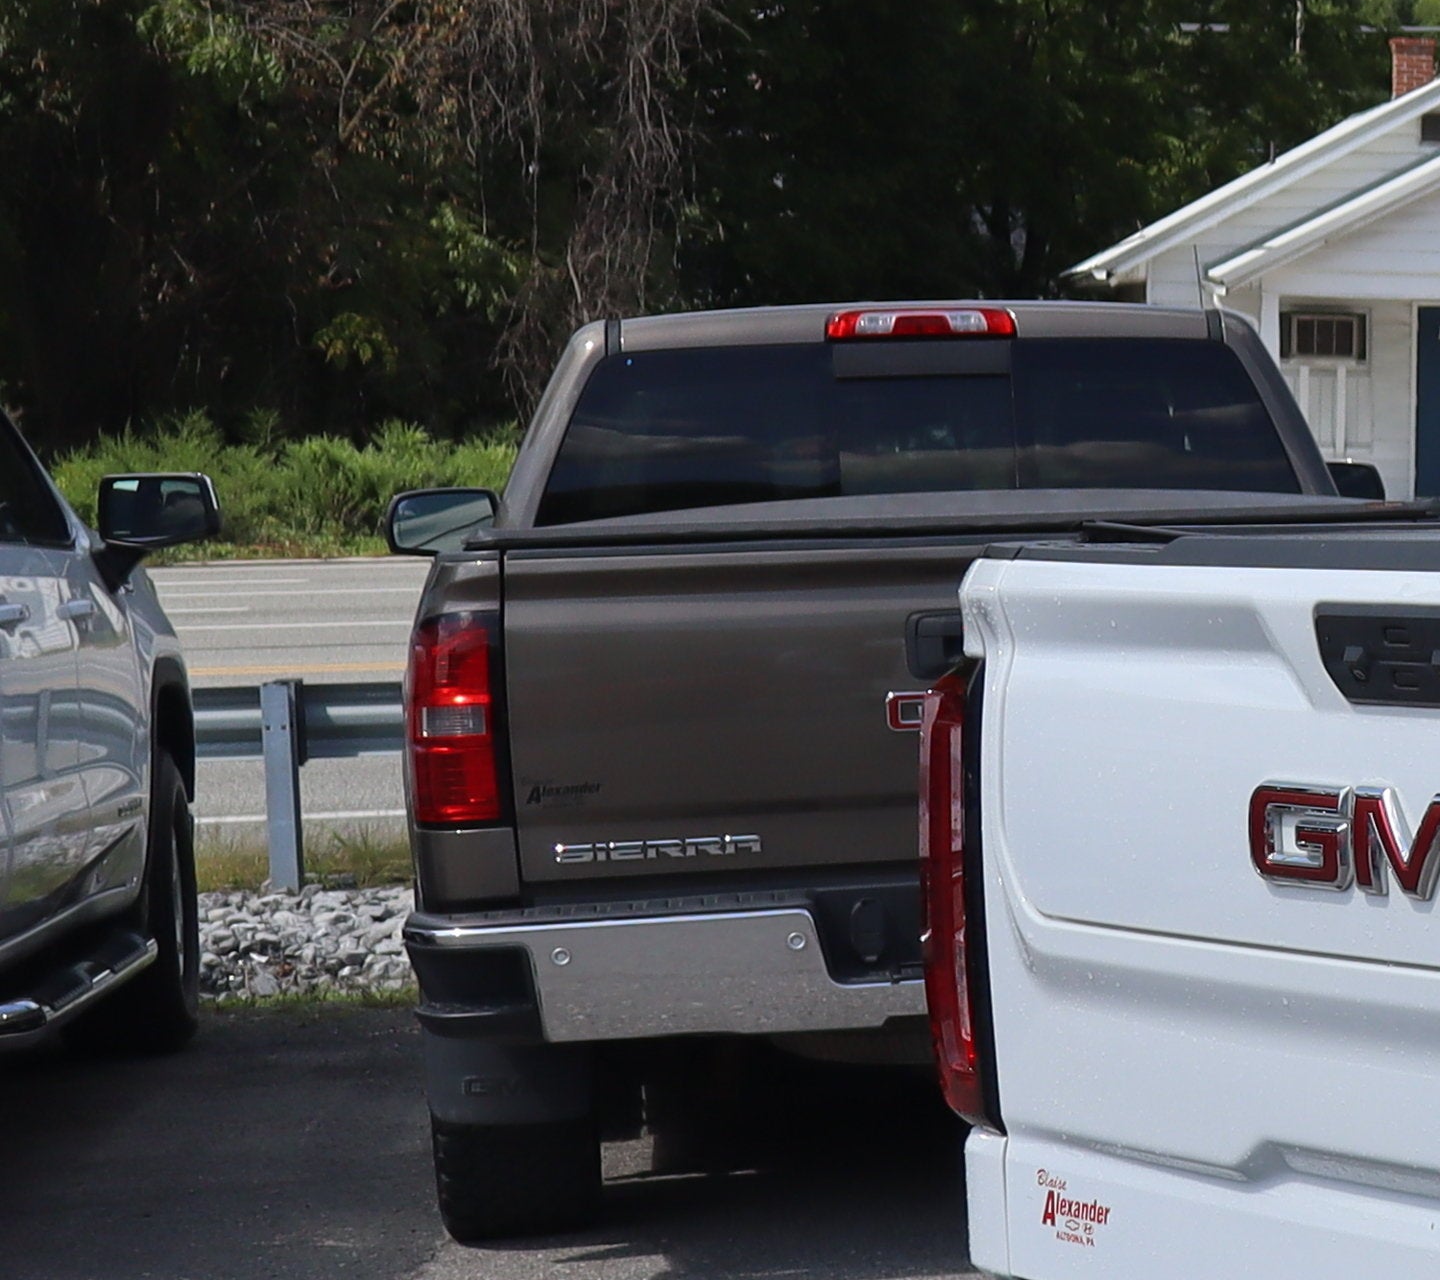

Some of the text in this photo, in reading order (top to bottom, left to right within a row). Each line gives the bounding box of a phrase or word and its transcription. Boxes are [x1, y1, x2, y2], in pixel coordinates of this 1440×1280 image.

[526, 781, 601, 804] Alexander
[553, 833, 762, 864] SIERRA
[1036, 1168, 1067, 1191] Blaise
[1042, 1189, 1111, 1227] Alexander
[1086, 1236, 1095, 1247] PA
